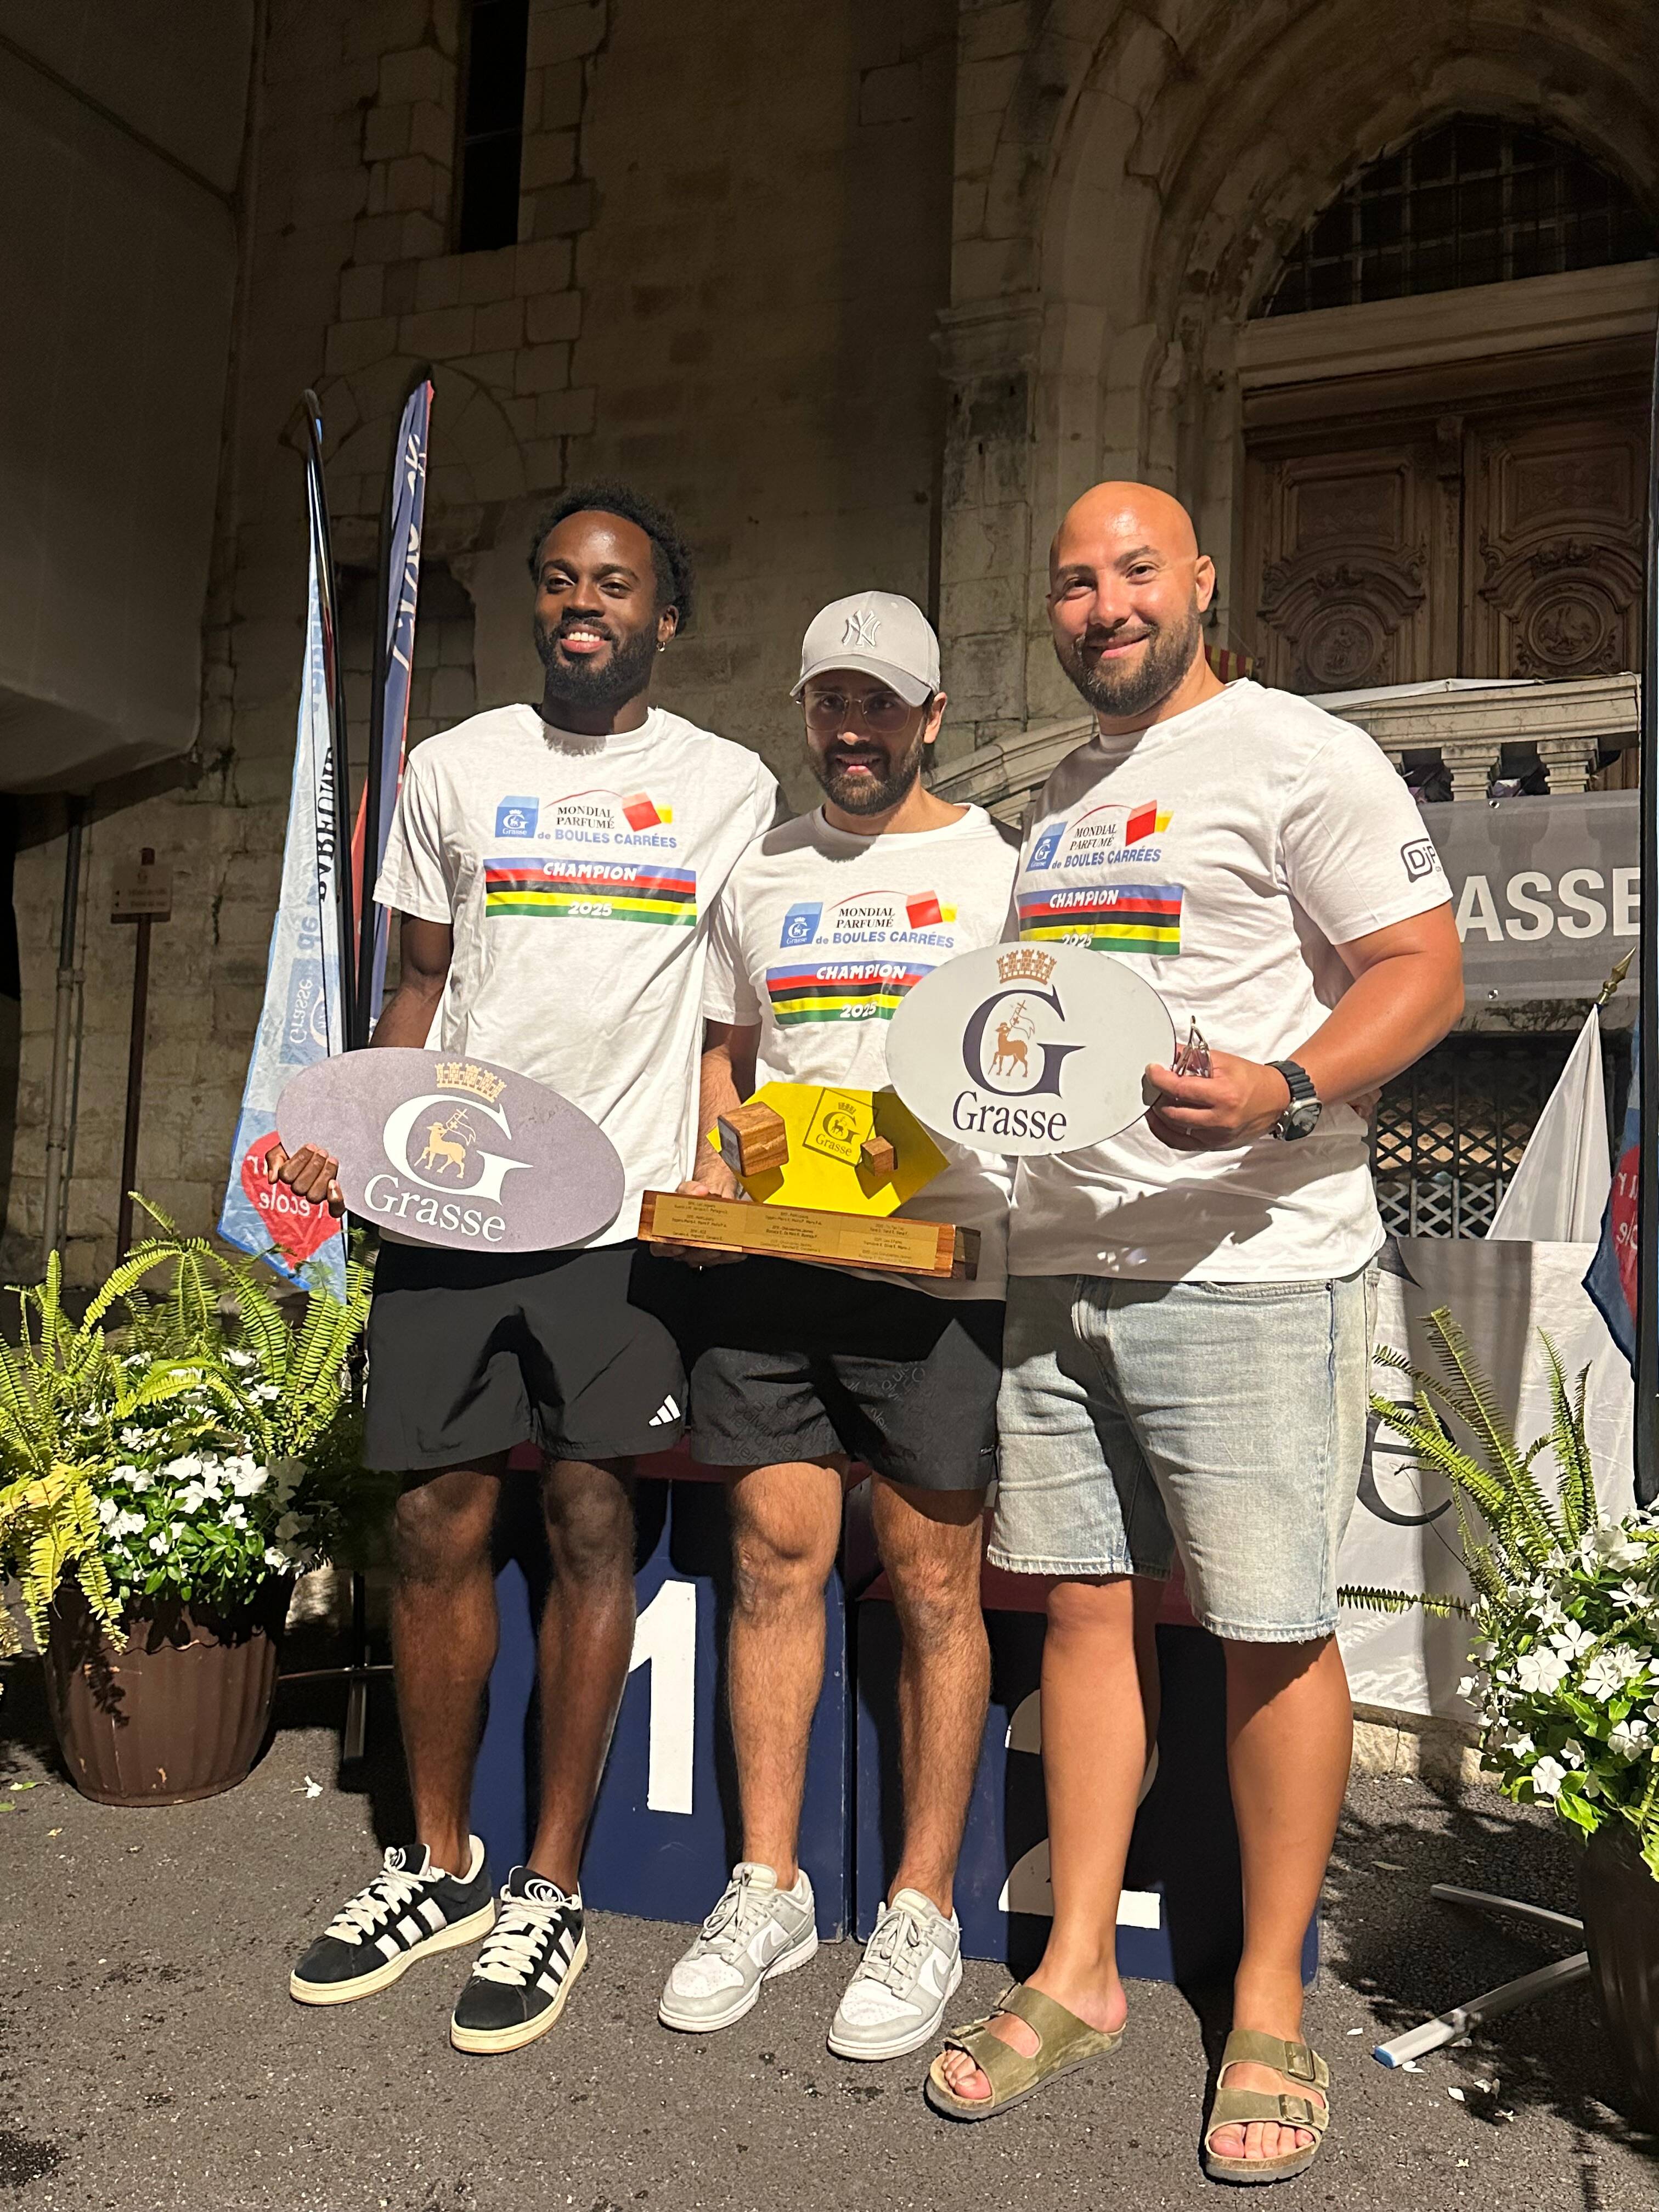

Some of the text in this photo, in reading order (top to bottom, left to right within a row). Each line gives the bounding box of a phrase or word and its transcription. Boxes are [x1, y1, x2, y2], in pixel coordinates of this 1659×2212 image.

[557, 806, 614, 819] MONDIAL
[556, 816, 614, 829] PARFUMÉ
[1075, 823, 1117, 838] MONDIAL
[538, 829, 677, 848] de BOULES CARRÉES
[1069, 835, 1114, 851] PARFUMÉ
[1052, 845, 1161, 870] de BOULES CARRÉES
[543, 862, 637, 881] CHAMPION
[1049, 889, 1119, 909] CHAMPION
[567, 901, 613, 916] 2025
[839, 907, 896, 917] MONDIAL
[836, 916, 894, 928] PARFUMÉ
[816, 930, 955, 948] de BOULES CARRÉES
[1062, 933, 1093, 948] 2025
[816, 964, 907, 980] CHAMPION
[839, 1001, 877, 1018] 2025
[952, 1091, 1067, 1142] Grasse
[816, 1133, 852, 1156] Grasse
[364, 1174, 506, 1243] Grasse
[628, 1579, 696, 1815] 1
